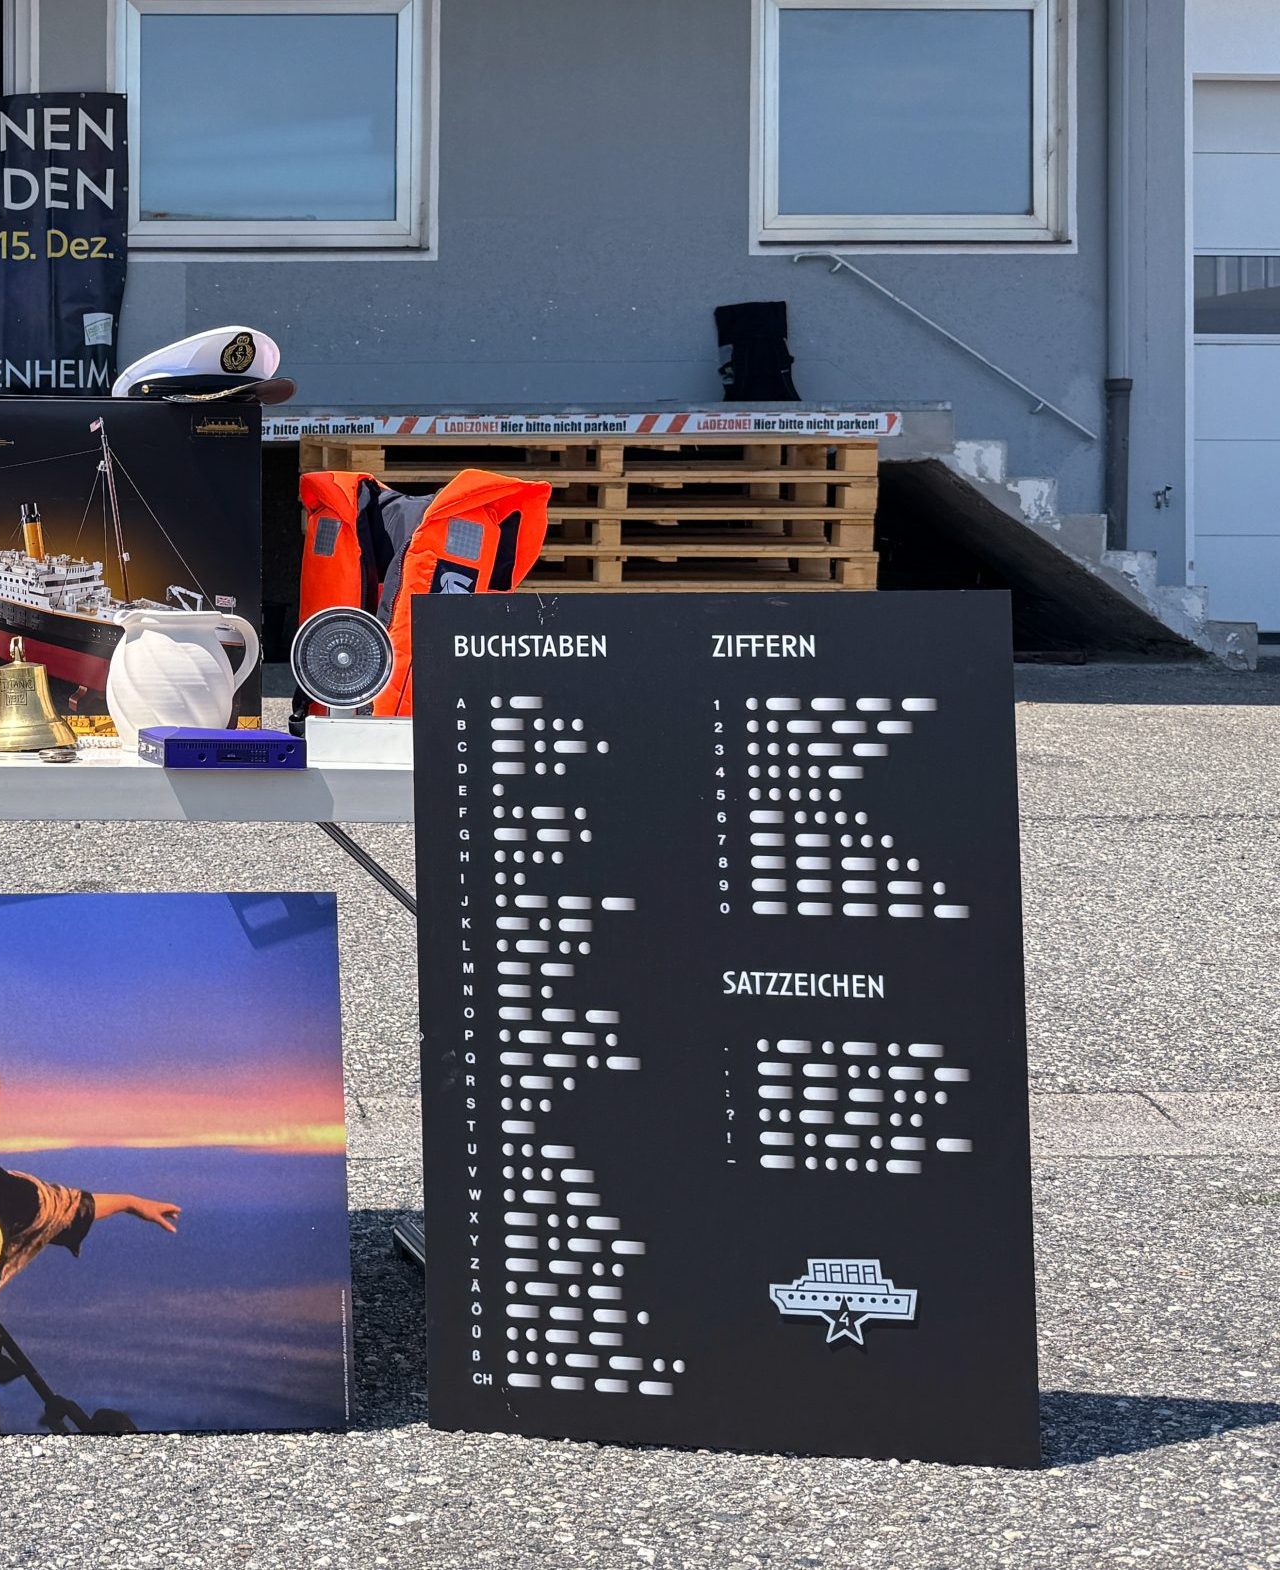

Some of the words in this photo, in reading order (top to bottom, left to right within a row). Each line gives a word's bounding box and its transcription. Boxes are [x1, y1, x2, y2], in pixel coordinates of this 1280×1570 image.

[46, 229, 114, 259] Dez.
[273, 424, 299, 435] bitte
[301, 424, 330, 434] nicht
[444, 421, 498, 433] LADEZONE!
[501, 421, 523, 433] Hier
[526, 421, 551, 433] bitte
[554, 421, 582, 433] nicht
[584, 421, 626, 433] parken!
[697, 419, 751, 430] LADEZONE!
[754, 419, 776, 430] Hier
[779, 419, 803, 430] bitte
[806, 419, 834, 430] nicht
[837, 419, 878, 432] parken!
[455, 635, 607, 658] BUCHSTABEN
[712, 635, 816, 658] ZIFFERN
[457, 698, 466, 709] A
[714, 700, 720, 711] 1
[457, 720, 467, 731] B
[715, 722, 724, 733] 2
[458, 742, 468, 753] C
[715, 745, 725, 756] 3
[458, 764, 468, 775] D
[716, 767, 726, 778] 4
[459, 786, 468, 796] E
[717, 790, 726, 801] 5
[459, 808, 468, 818] F
[717, 812, 727, 824] 6
[460, 829, 470, 841] G
[718, 835, 727, 846] 7
[460, 852, 470, 863] H
[719, 857, 729, 869] 8
[719, 880, 729, 892] 9
[461, 896, 469, 907] J
[720, 903, 730, 914] 0
[462, 918, 472, 929] K
[463, 940, 471, 952] L
[463, 963, 474, 974] M
[464, 985, 473, 996] N
[723, 971, 884, 999] SATZZEICHEN
[464, 1008, 475, 1019] O
[465, 1030, 474, 1041] P
[465, 1053, 476, 1064] Q
[466, 1075, 476, 1087] R
[467, 1098, 476, 1110] S
[726, 1109, 735, 1121] ?
[467, 1121, 477, 1132] T
[726, 1132, 732, 1144] !
[468, 1144, 477, 1155] U
[468, 1167, 478, 1178] V
[469, 1189, 482, 1201] W
[470, 1212, 479, 1224] X
[470, 1235, 479, 1247] Y
[471, 1258, 480, 1270] Z
[471, 1279, 481, 1293] Ä
[472, 1302, 483, 1316] Ö
[839, 1311, 850, 1327] 4
[473, 1373, 493, 1386] CH
